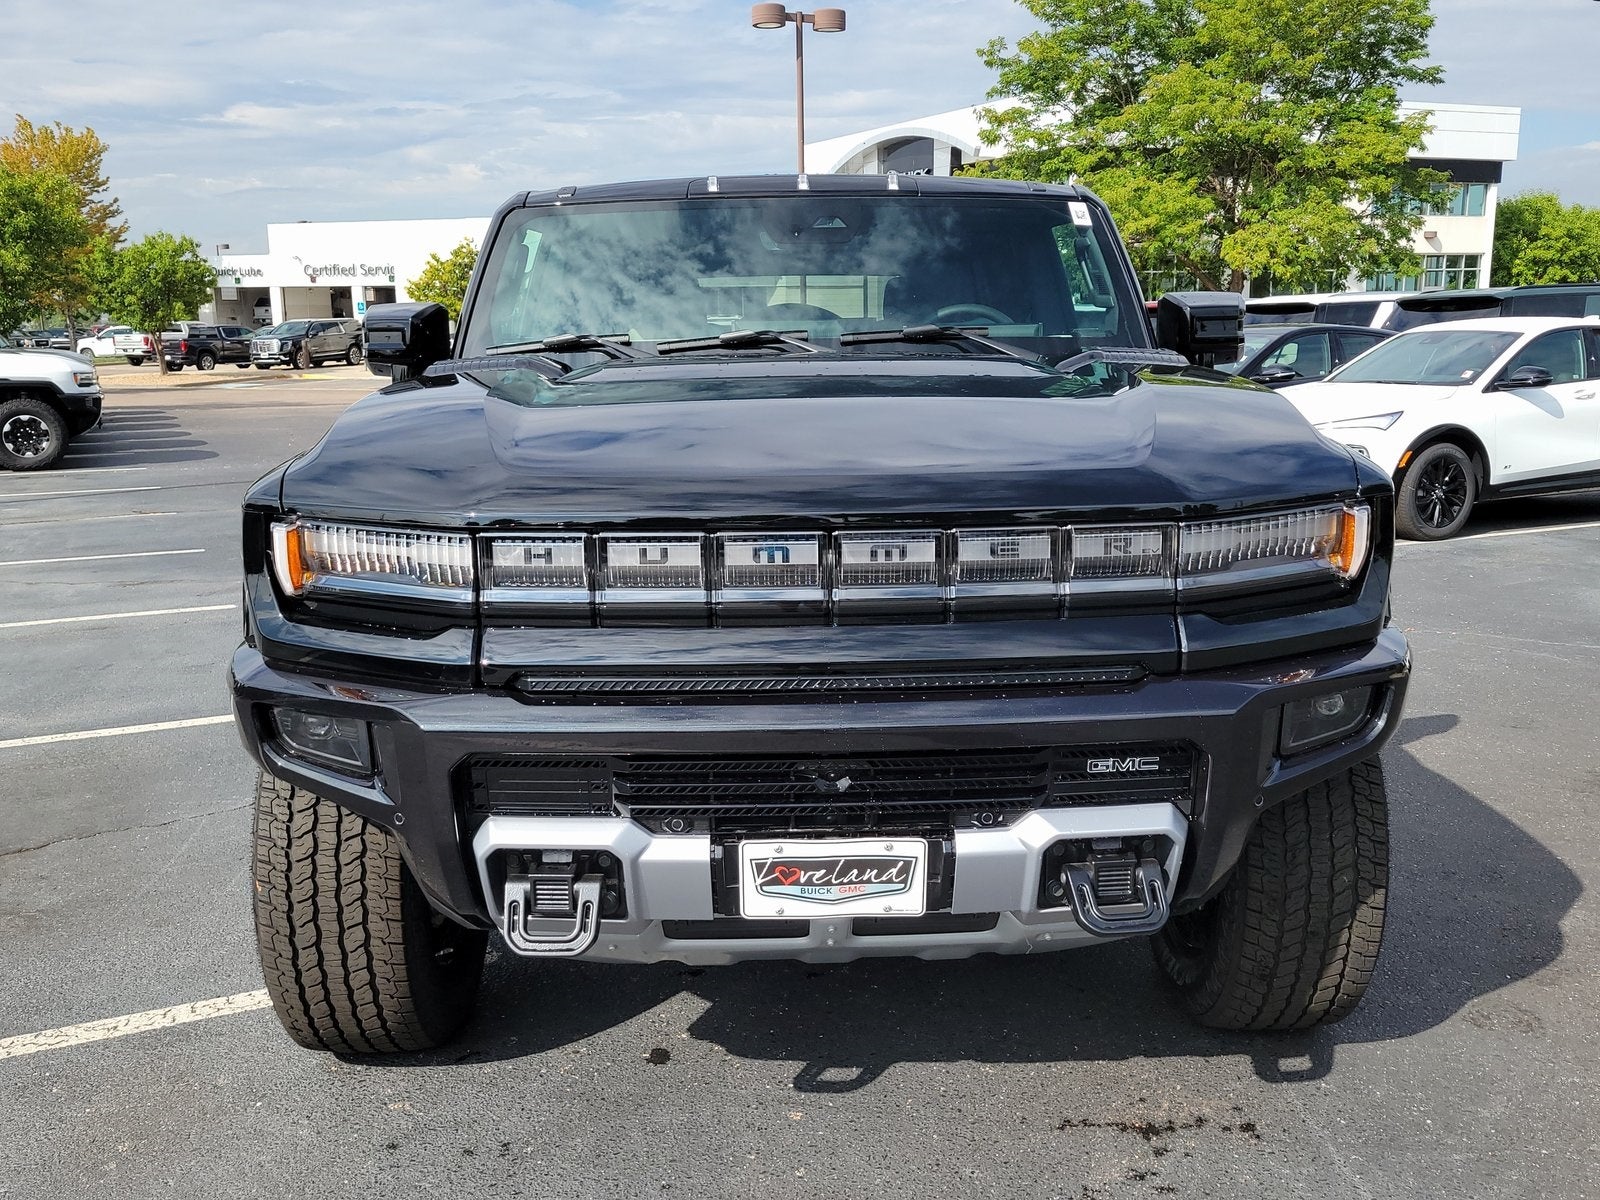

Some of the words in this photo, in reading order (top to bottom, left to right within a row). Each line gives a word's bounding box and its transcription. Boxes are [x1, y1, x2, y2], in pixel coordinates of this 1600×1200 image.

[239, 266, 264, 277] Lube
[304, 263, 356, 277] Certified
[1087, 757, 1160, 773] GMC
[800, 887, 833, 895] BUICK
[838, 885, 866, 893] GMC
